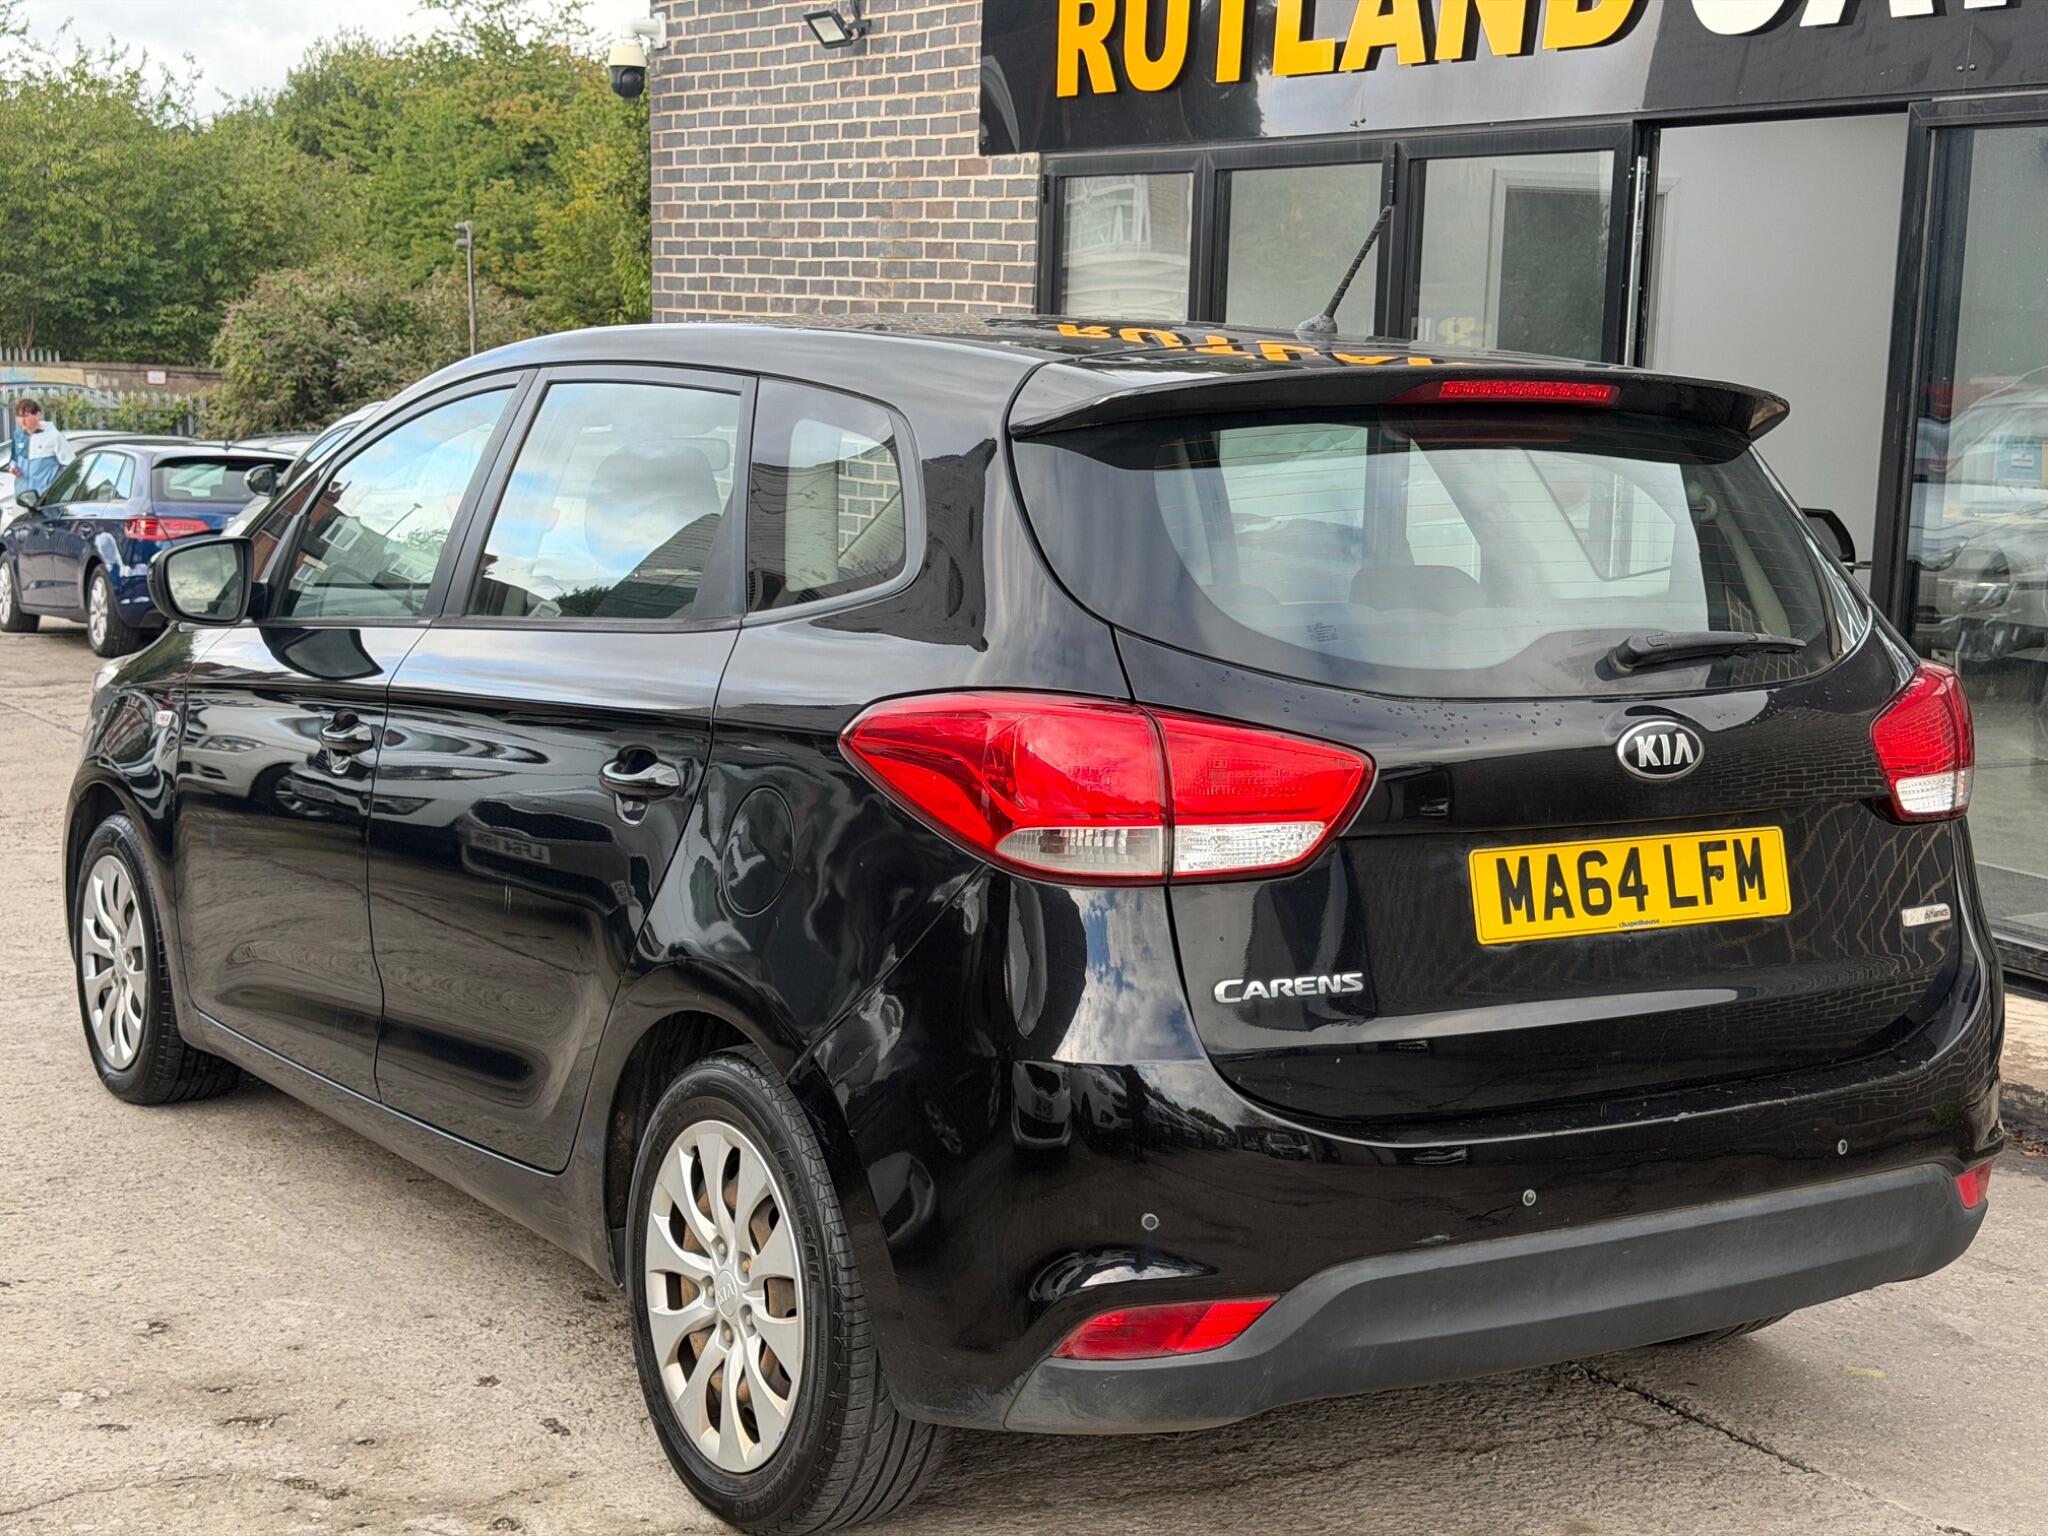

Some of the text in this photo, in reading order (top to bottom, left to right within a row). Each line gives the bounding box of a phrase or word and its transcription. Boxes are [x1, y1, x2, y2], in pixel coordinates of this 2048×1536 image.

[1634, 733, 1694, 767] KIA
[1496, 837, 1767, 925] MA64 LFM
[1214, 972, 1363, 1004] CARENS
